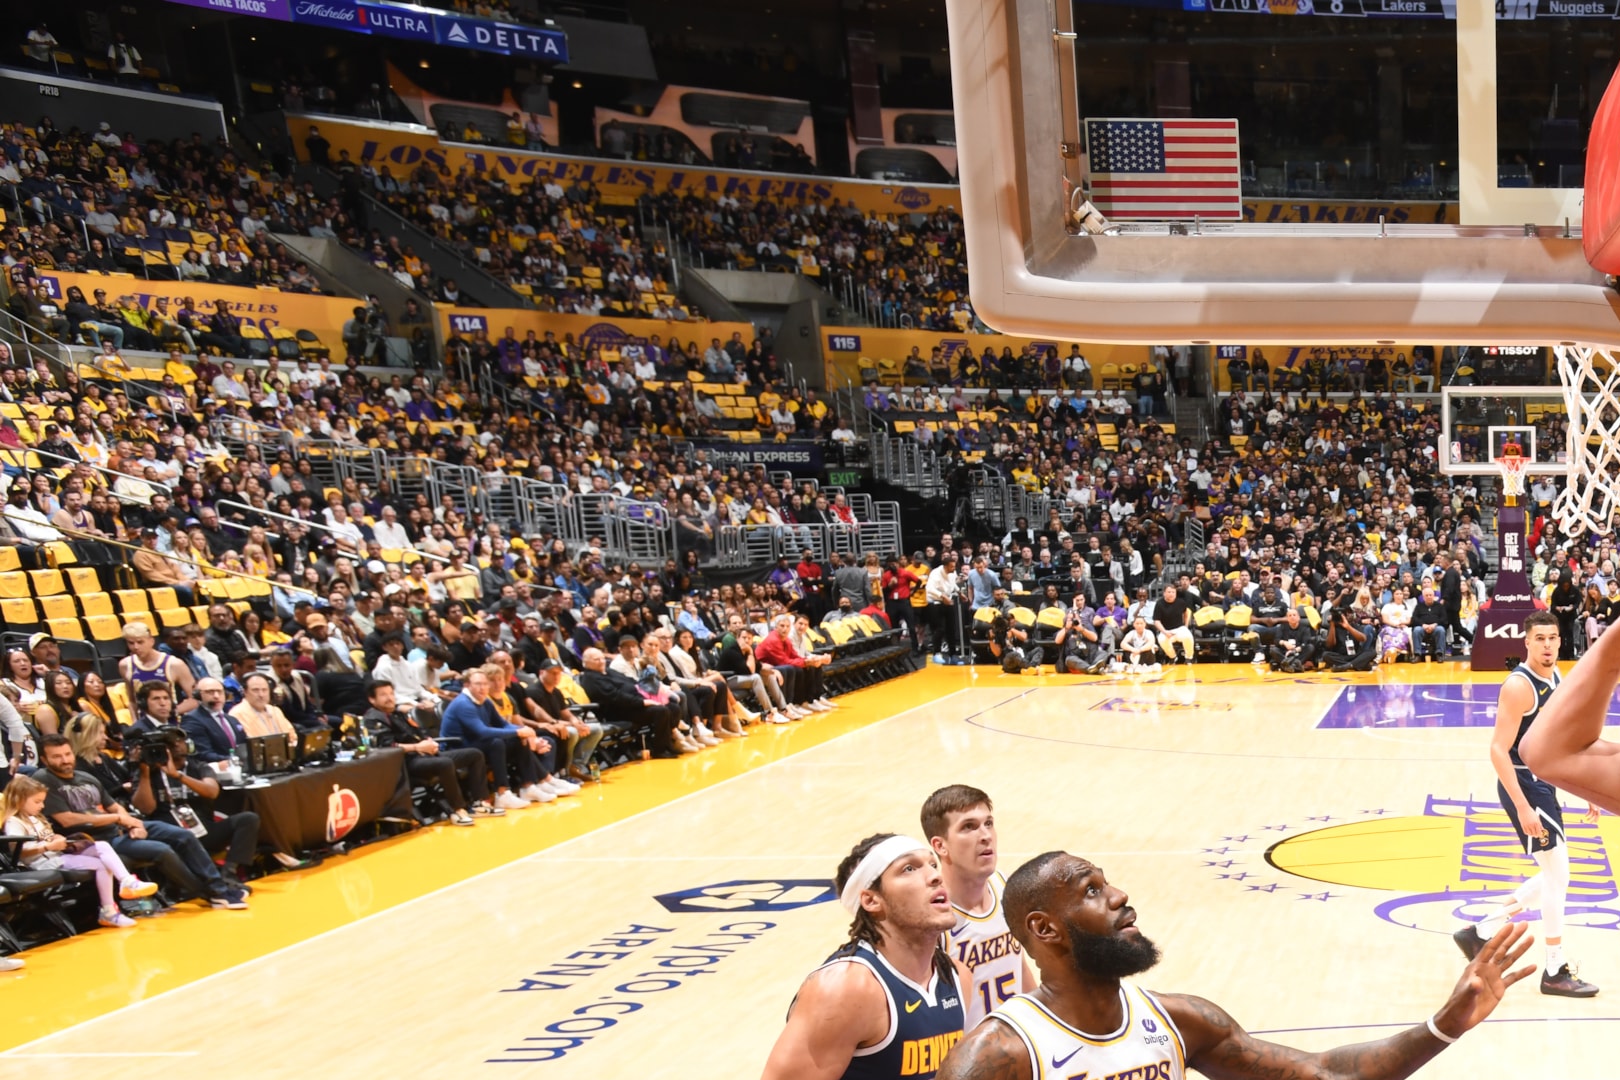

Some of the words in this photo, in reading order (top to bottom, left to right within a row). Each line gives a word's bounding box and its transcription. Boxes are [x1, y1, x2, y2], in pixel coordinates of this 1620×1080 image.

[235, 0, 267, 13] TACOS
[1381, 0, 1426, 12] Lakers
[1549, 1, 1605, 15] Nuggets
[296, 1, 355, 21] Michelob
[370, 12, 428, 34] ULTRA
[475, 26, 560, 56] DELTA
[455, 317, 483, 331] 114
[834, 337, 861, 350] 115
[1498, 347, 1539, 355] TISSOT
[753, 451, 811, 463] EXPRESS
[830, 472, 856, 485] EXIT
[1505, 532, 1519, 545] GET
[1505, 545, 1519, 557] THE
[1509, 559, 1522, 572] App
[498, 923, 677, 993] ARENA
[484, 921, 778, 1063] crypto.com
[1144, 1034, 1169, 1046] bibigo
